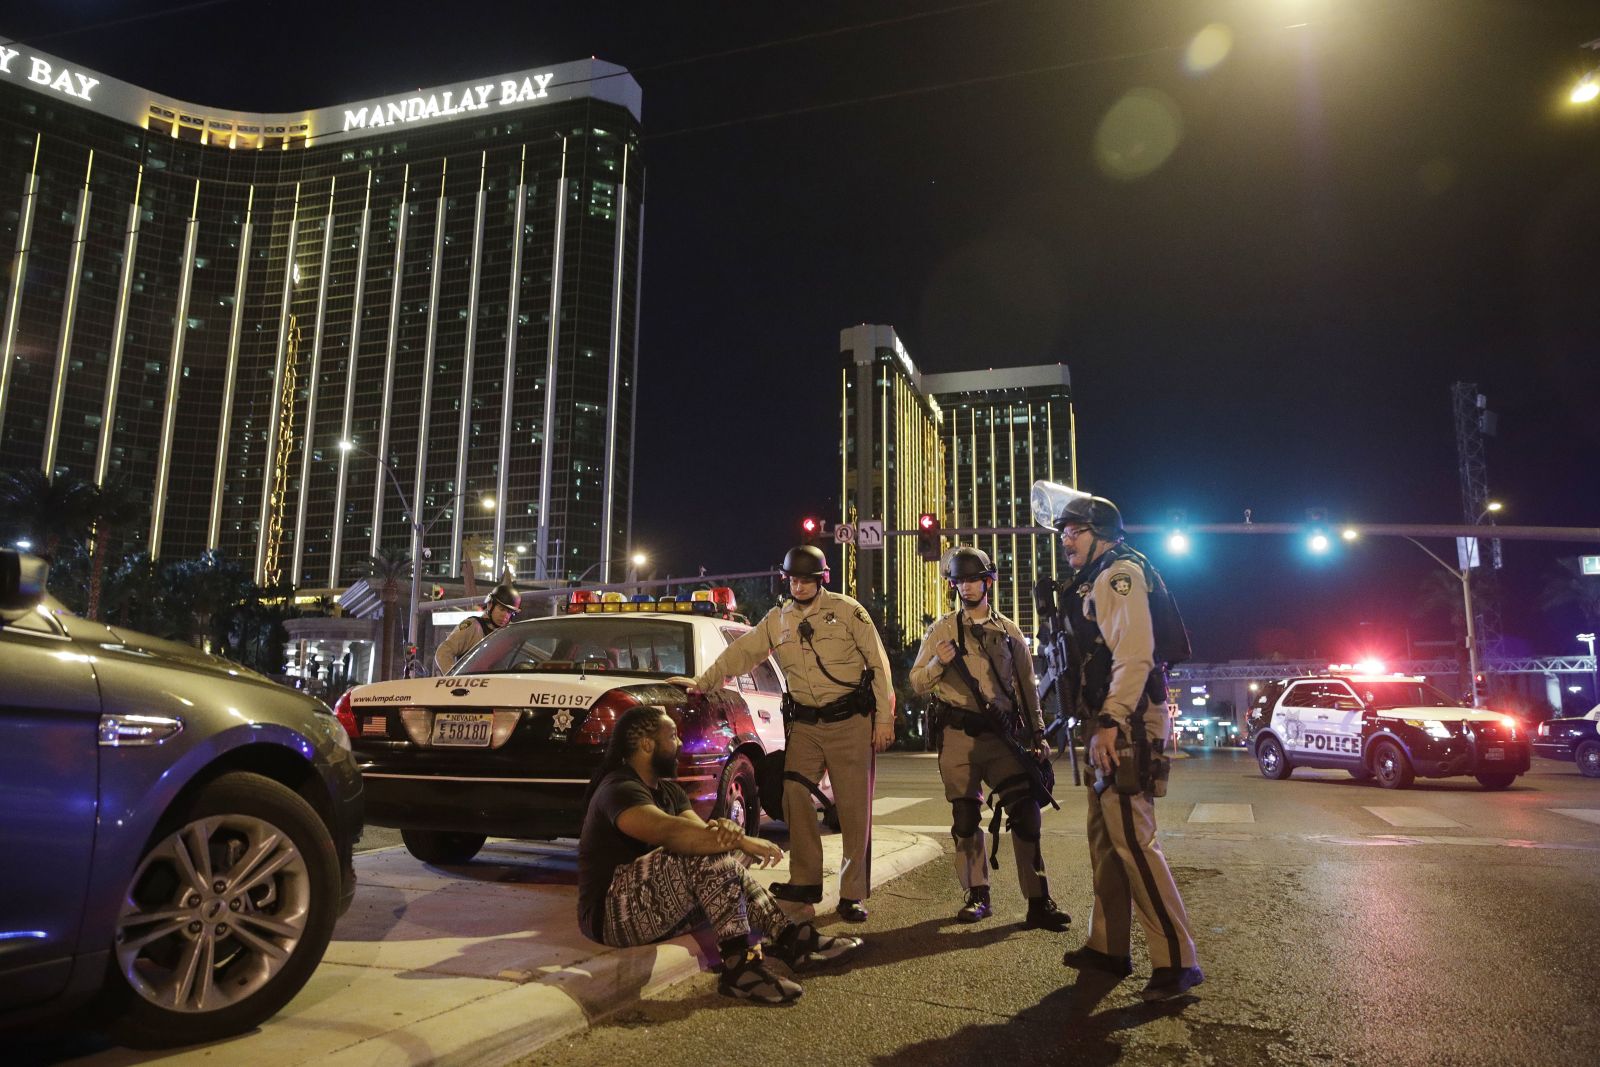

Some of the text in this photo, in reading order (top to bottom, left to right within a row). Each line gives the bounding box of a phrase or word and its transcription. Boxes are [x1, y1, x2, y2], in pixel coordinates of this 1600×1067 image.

[0, 45, 100, 101] Y BAY
[343, 72, 554, 132] MANDALAY BAY
[435, 678, 490, 688] POLICE
[353, 694, 412, 704] www.lvmpd.com
[529, 693, 593, 707] NE10197
[1304, 734, 1360, 754] POLICE
